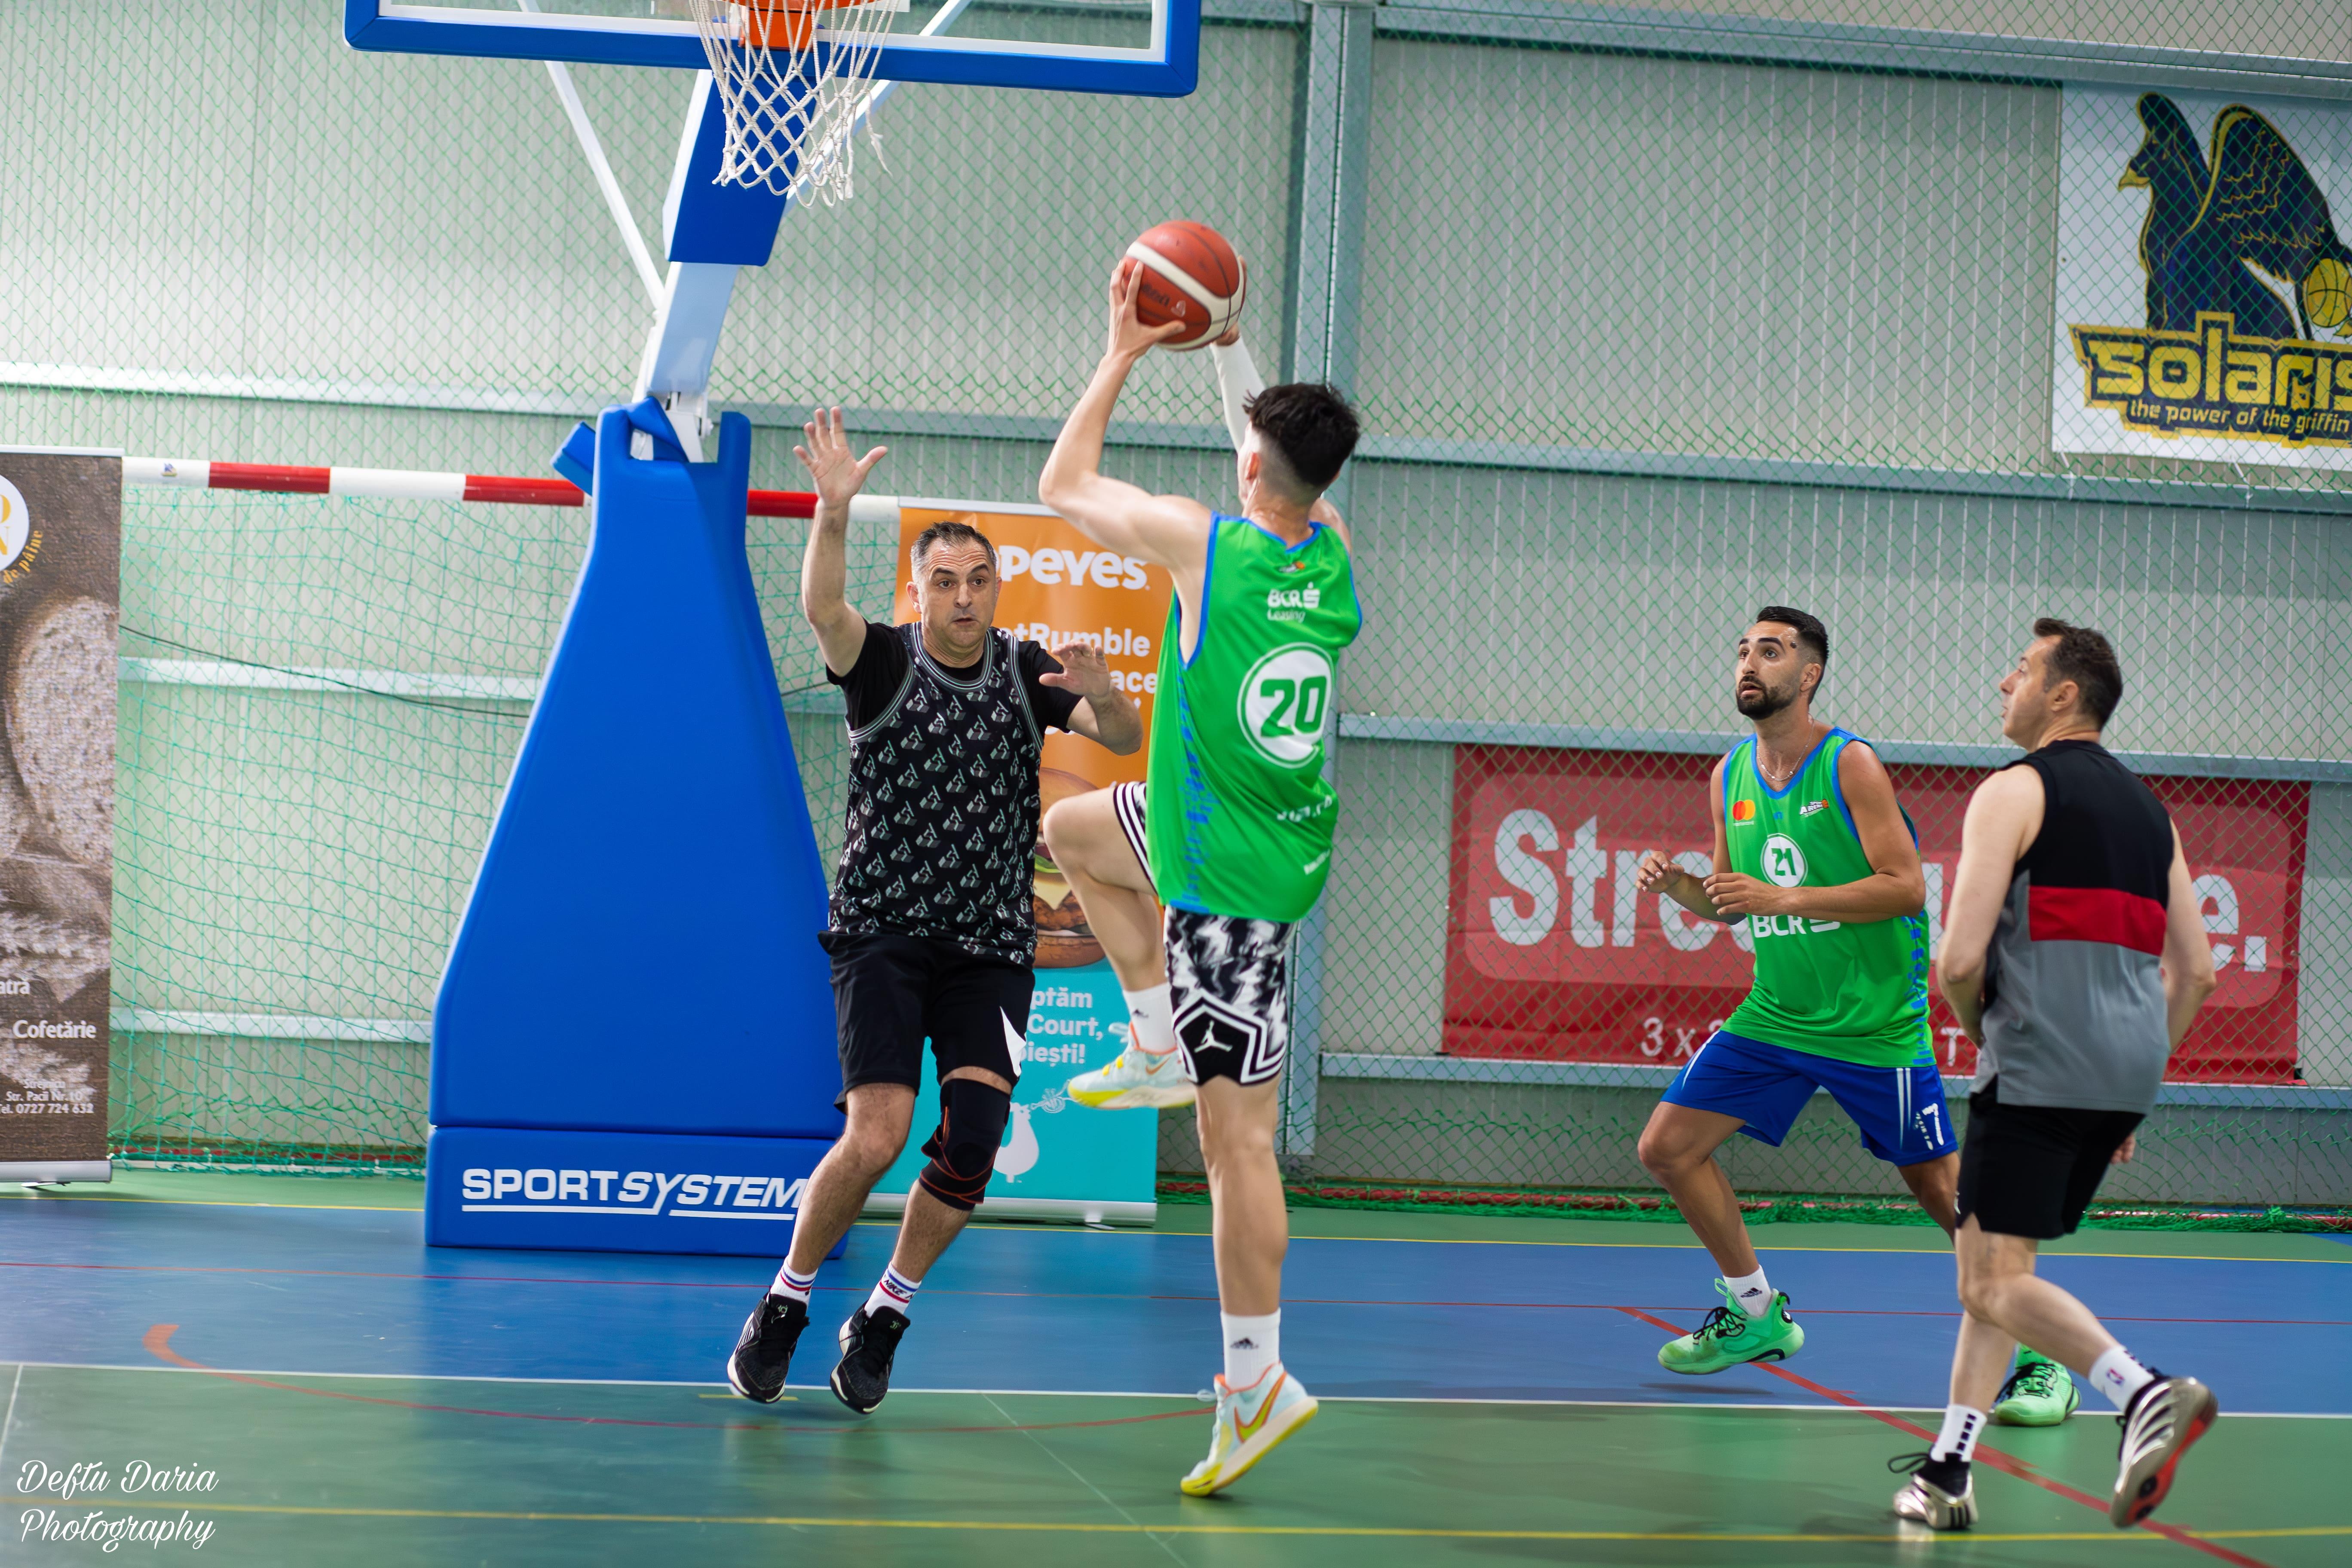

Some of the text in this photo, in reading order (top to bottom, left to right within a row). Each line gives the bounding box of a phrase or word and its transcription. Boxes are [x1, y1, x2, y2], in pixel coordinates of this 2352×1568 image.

[2130, 398, 2351, 434] the power of the griffin
[1268, 588, 1303, 608] BCR
[1259, 676, 1328, 738] 20
[1771, 848, 1797, 877] 21
[1752, 914, 1807, 938] BCR
[12, 1020, 97, 1039] Cofetărie
[1027, 1014, 1103, 1041] Court,
[15, 1103, 45, 1114] 0727
[47, 1103, 69, 1114] 724
